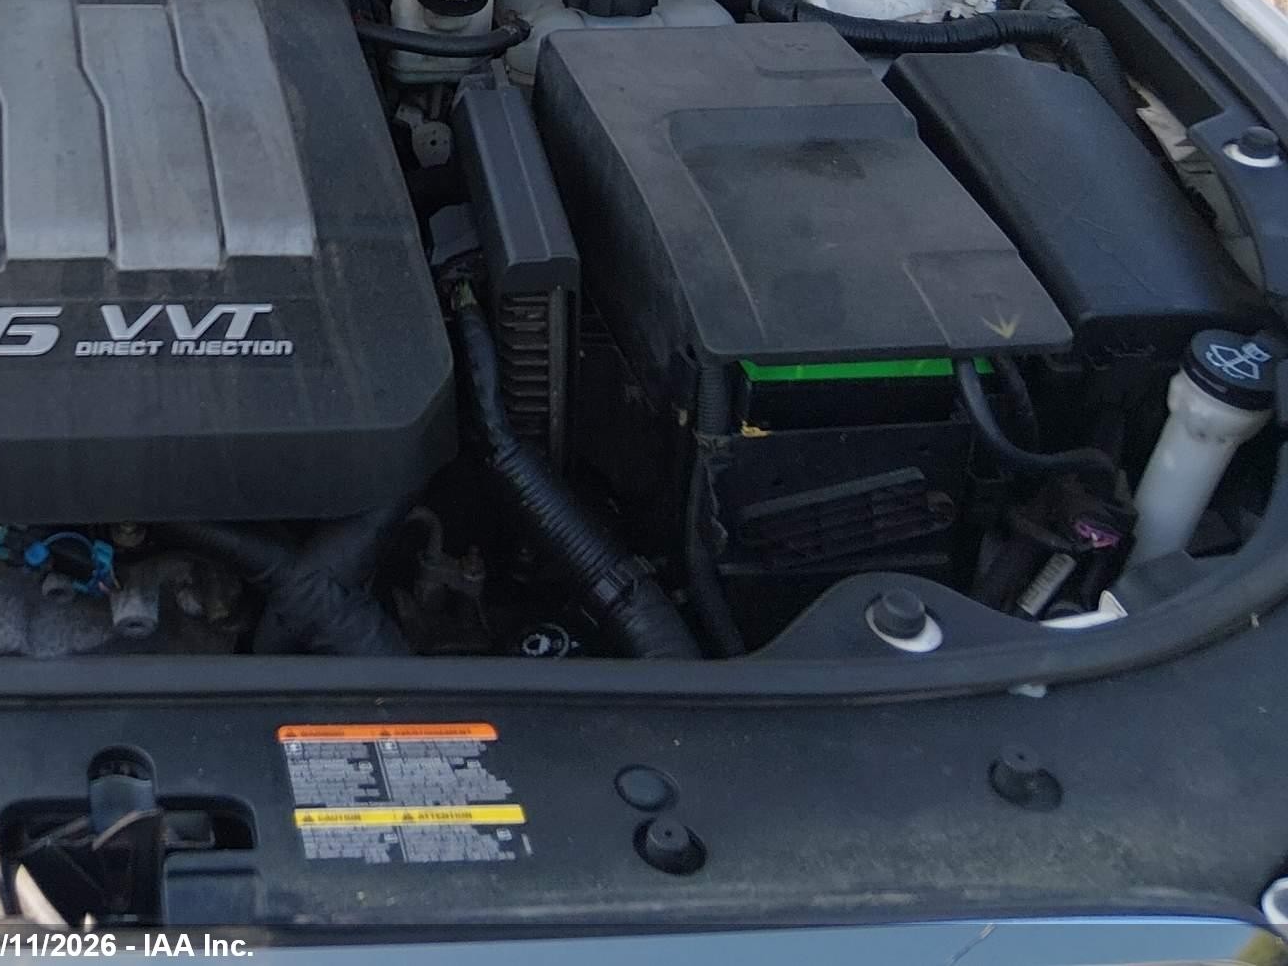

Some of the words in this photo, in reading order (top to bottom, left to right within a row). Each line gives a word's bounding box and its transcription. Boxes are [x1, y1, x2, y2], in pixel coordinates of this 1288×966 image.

[100, 303, 273, 340] VVT
[75, 340, 162, 356] DIRECT
[171, 340, 293, 356] INJECTION
